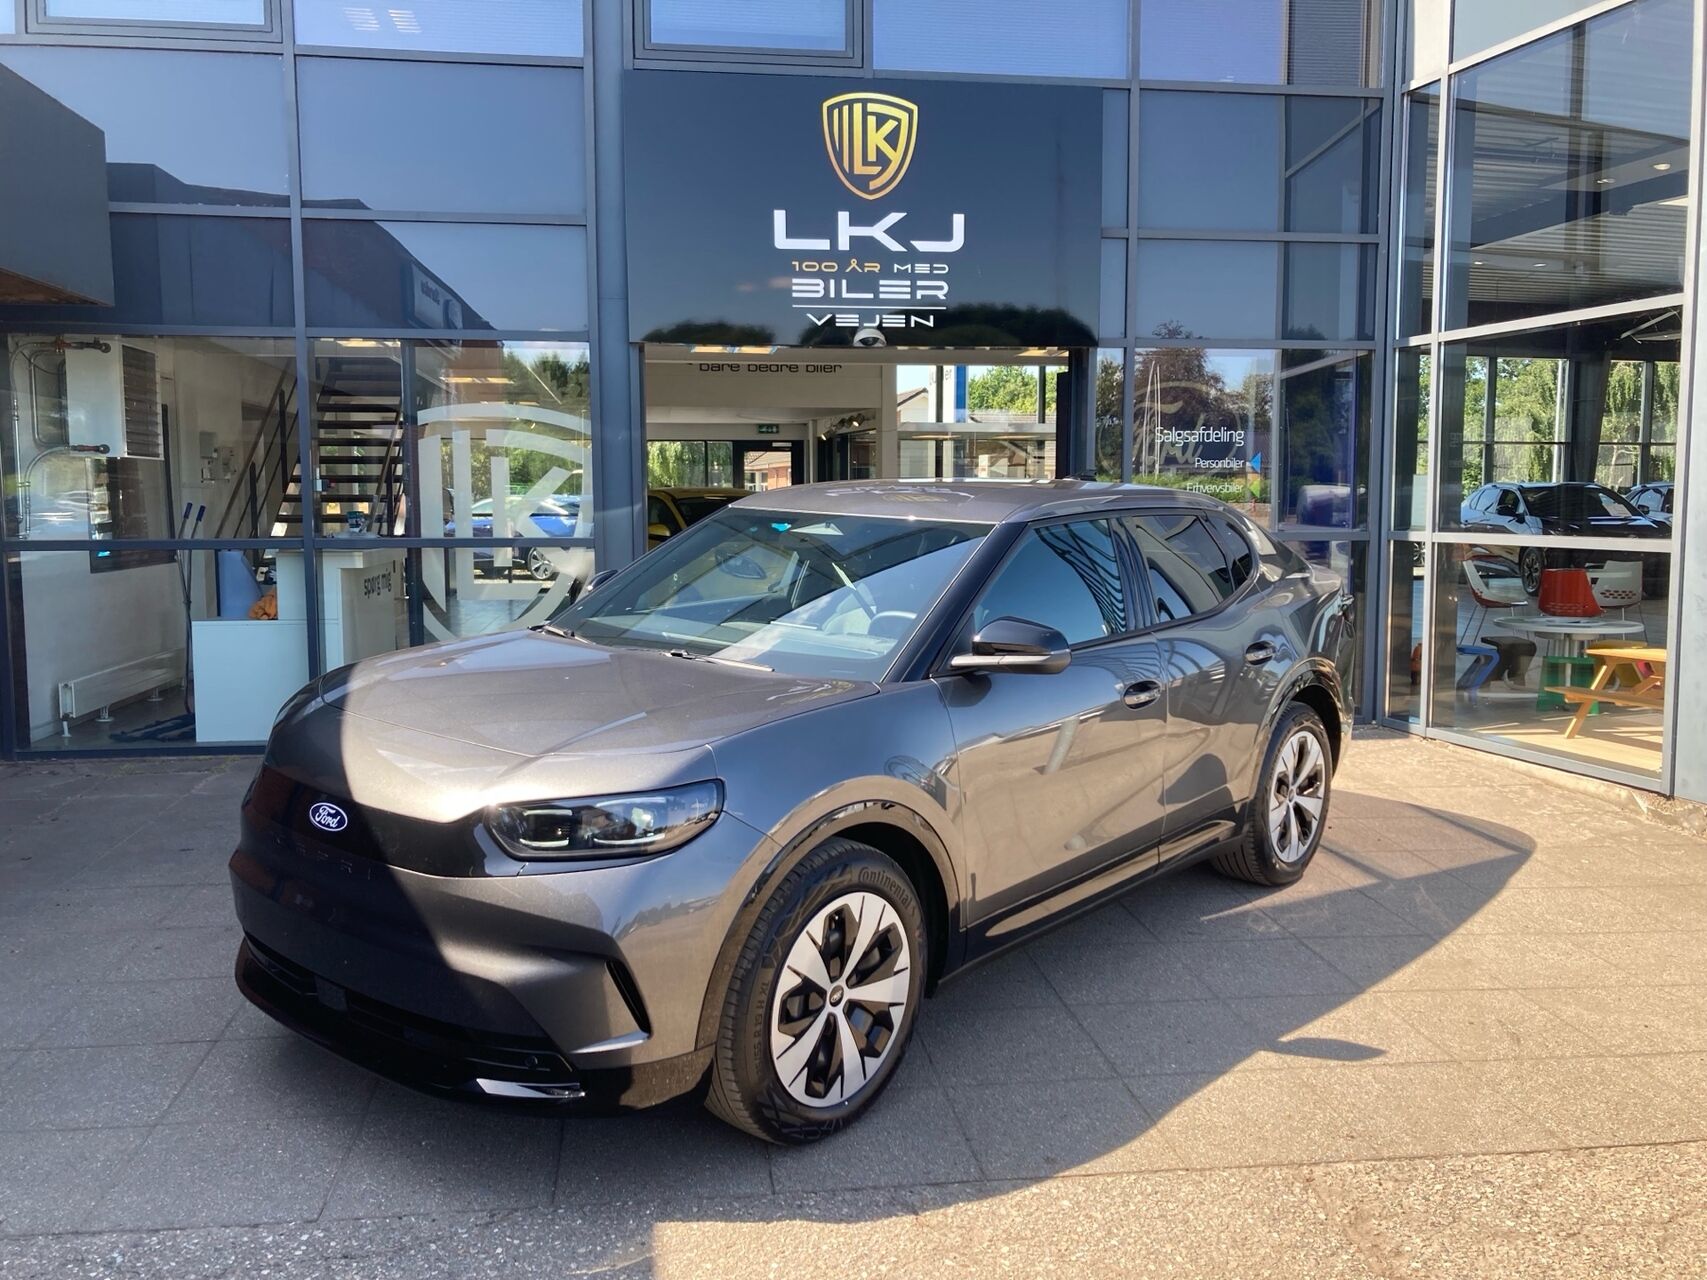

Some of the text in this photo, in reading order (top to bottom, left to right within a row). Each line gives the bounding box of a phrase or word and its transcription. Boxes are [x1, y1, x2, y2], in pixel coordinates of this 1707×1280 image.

[773, 209, 965, 252] LKJ
[791, 258, 950, 275] 100 ÅR MED
[791, 278, 950, 300] BILER
[806, 313, 934, 328] VEJEN
[1154, 426, 1245, 447] Salgsafdeling
[1194, 457, 1245, 469] Personbiler
[1186, 482, 1243, 493] Erhvervsbiler
[314, 805, 341, 828] Ford
[858, 866, 913, 909] Continental
